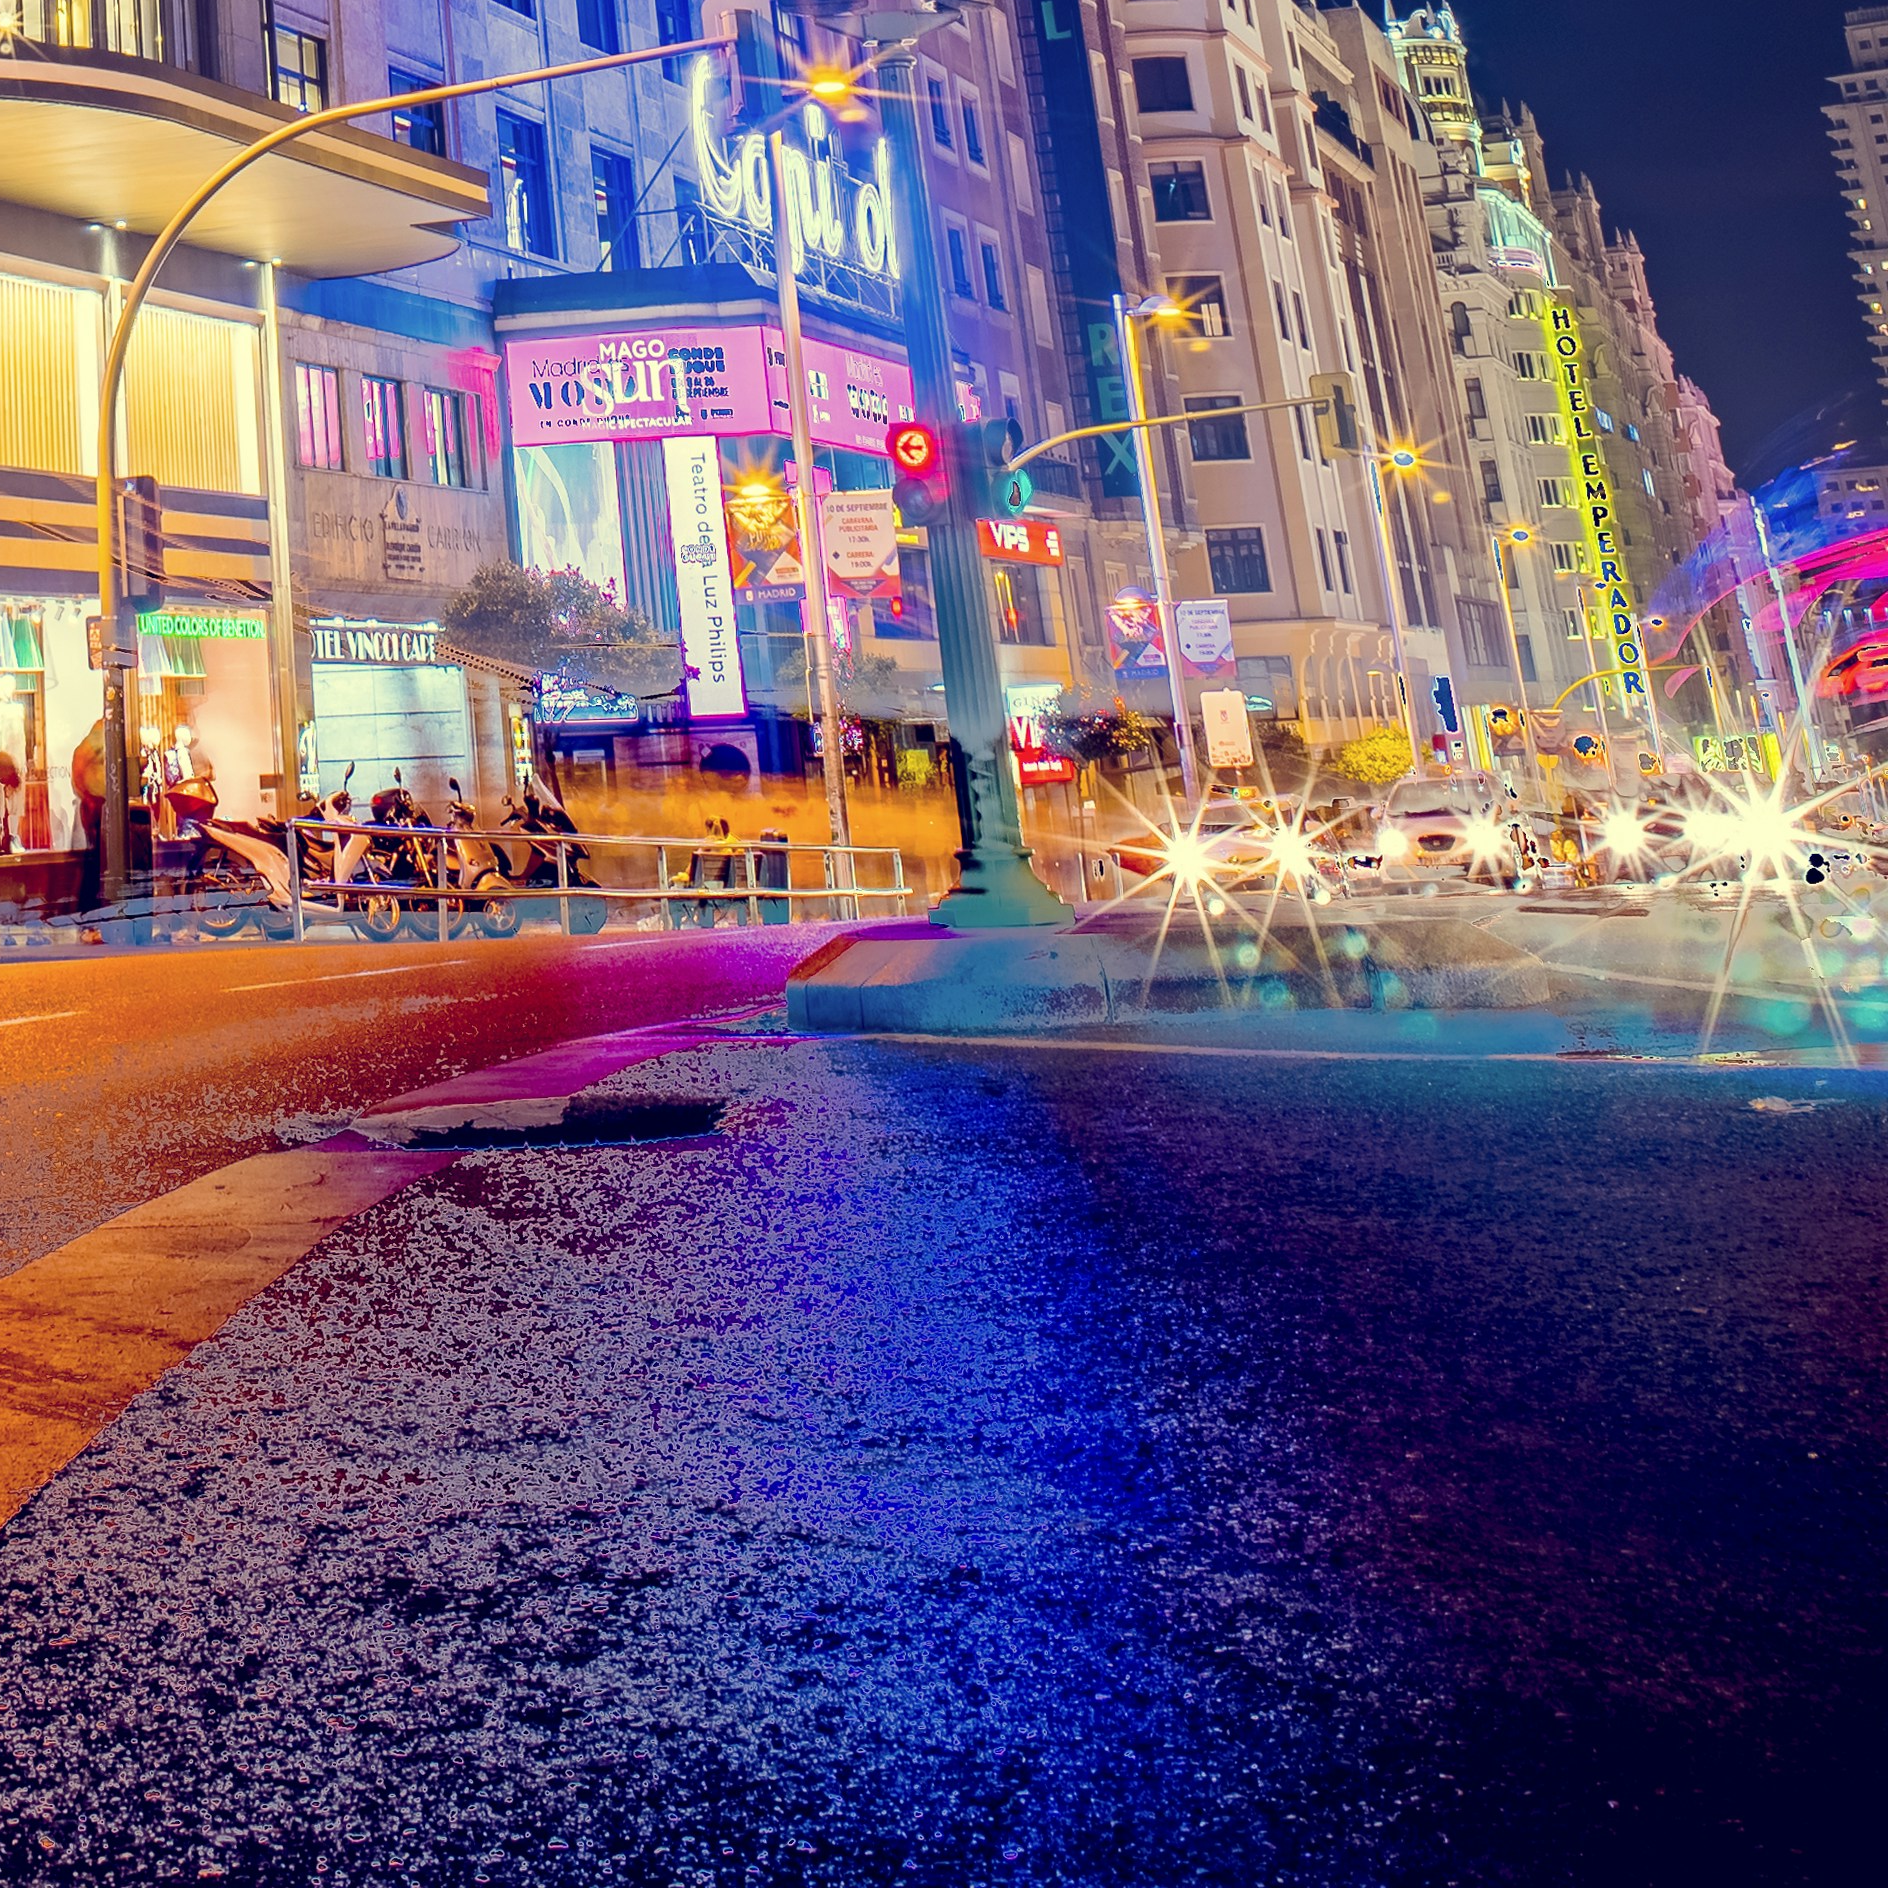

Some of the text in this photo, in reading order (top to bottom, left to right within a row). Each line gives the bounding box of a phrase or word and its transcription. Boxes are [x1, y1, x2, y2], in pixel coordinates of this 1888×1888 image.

[598, 339, 666, 360] MAGO
[690, 452, 707, 516] Teatro
[835, 504, 845, 513] DE
[1550, 308, 1645, 695] HOTEL EMPERADOR
[989, 521, 1031, 553] VIPS
[702, 574, 719, 610] Luz
[757, 587, 797, 599] MADRID
[142, 614, 174, 636] UNITED
[175, 615, 209, 637] COLORS
[209, 617, 221, 637] OF
[346, 631, 399, 662] VINCCI
[707, 616, 730, 684] Philips
